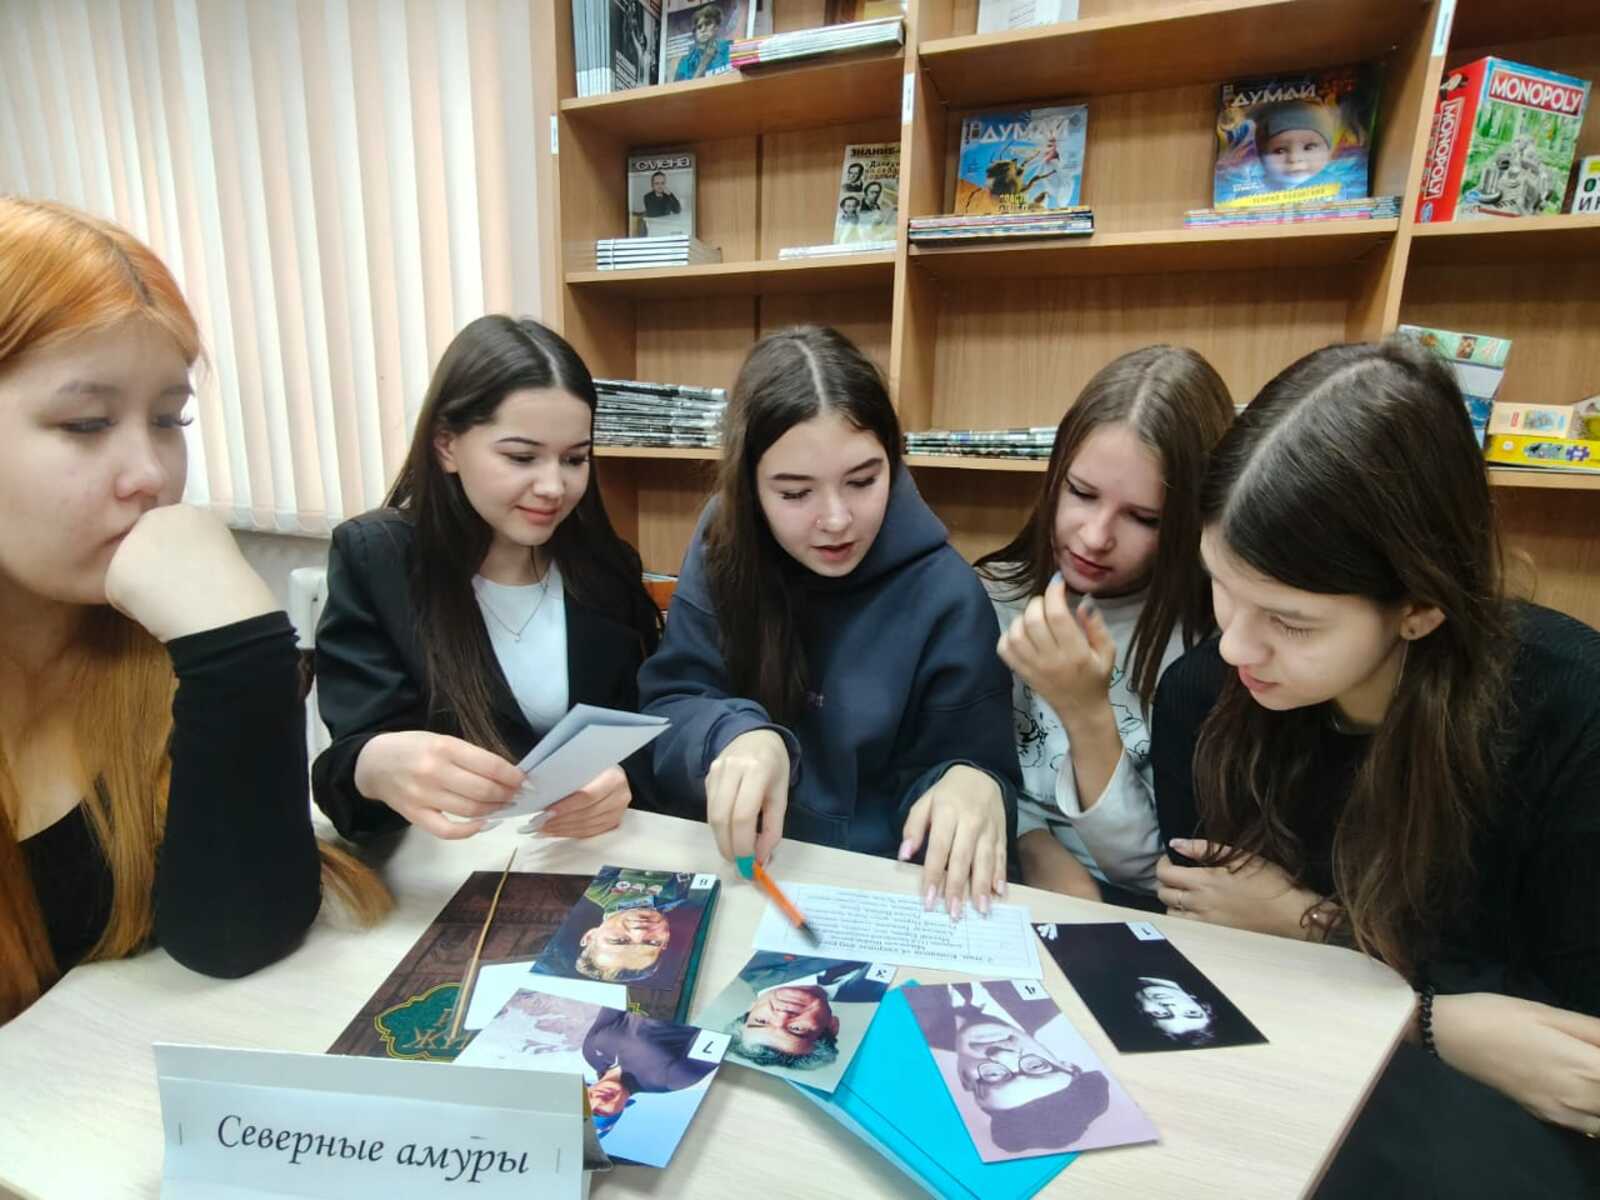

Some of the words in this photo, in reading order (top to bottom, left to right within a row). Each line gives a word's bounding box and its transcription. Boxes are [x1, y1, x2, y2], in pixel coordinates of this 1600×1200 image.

[1490, 75, 1582, 112] MONOPOLY
[1428, 102, 1457, 194] MONOPOLY
[702, 1040, 714, 1054] 7
[217, 1114, 385, 1165] Северные
[396, 1142, 529, 1184] амуры
